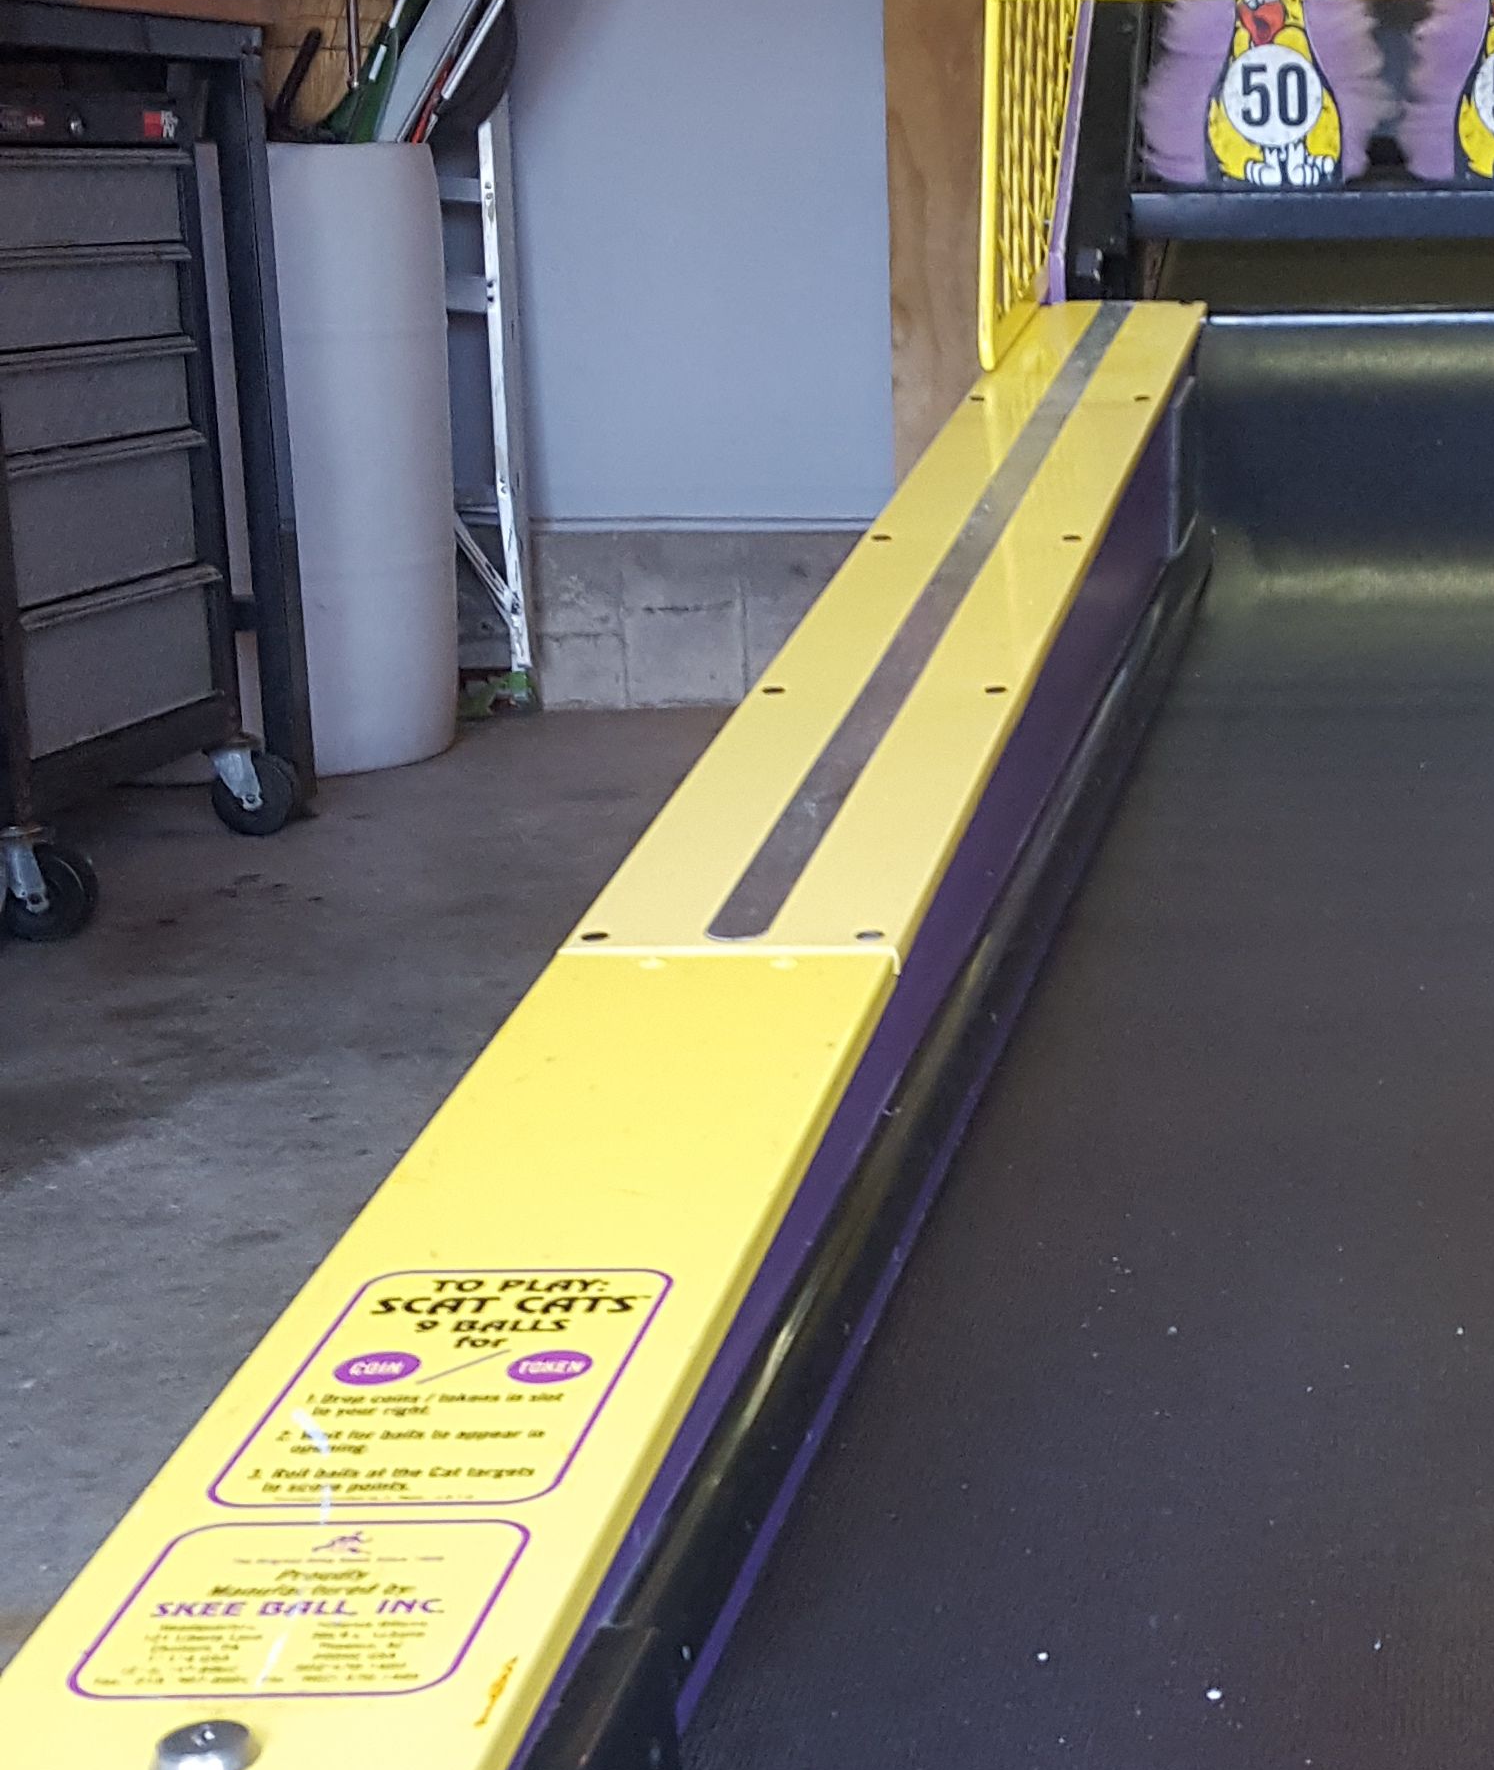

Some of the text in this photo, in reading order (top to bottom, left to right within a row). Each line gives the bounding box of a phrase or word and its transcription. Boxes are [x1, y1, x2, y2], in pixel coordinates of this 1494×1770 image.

[1241, 63, 1308, 126] 50
[433, 1278, 610, 1293] TO PLAY:
[371, 1297, 501, 1315] SCAT
[415, 1319, 571, 1333] 9 BALLS
[454, 1336, 509, 1349] for
[518, 1360, 587, 1375] TOKEN
[335, 1407, 378, 1418] your
[428, 1467, 464, 1478] Cat
[150, 1601, 246, 1618] SKEE
